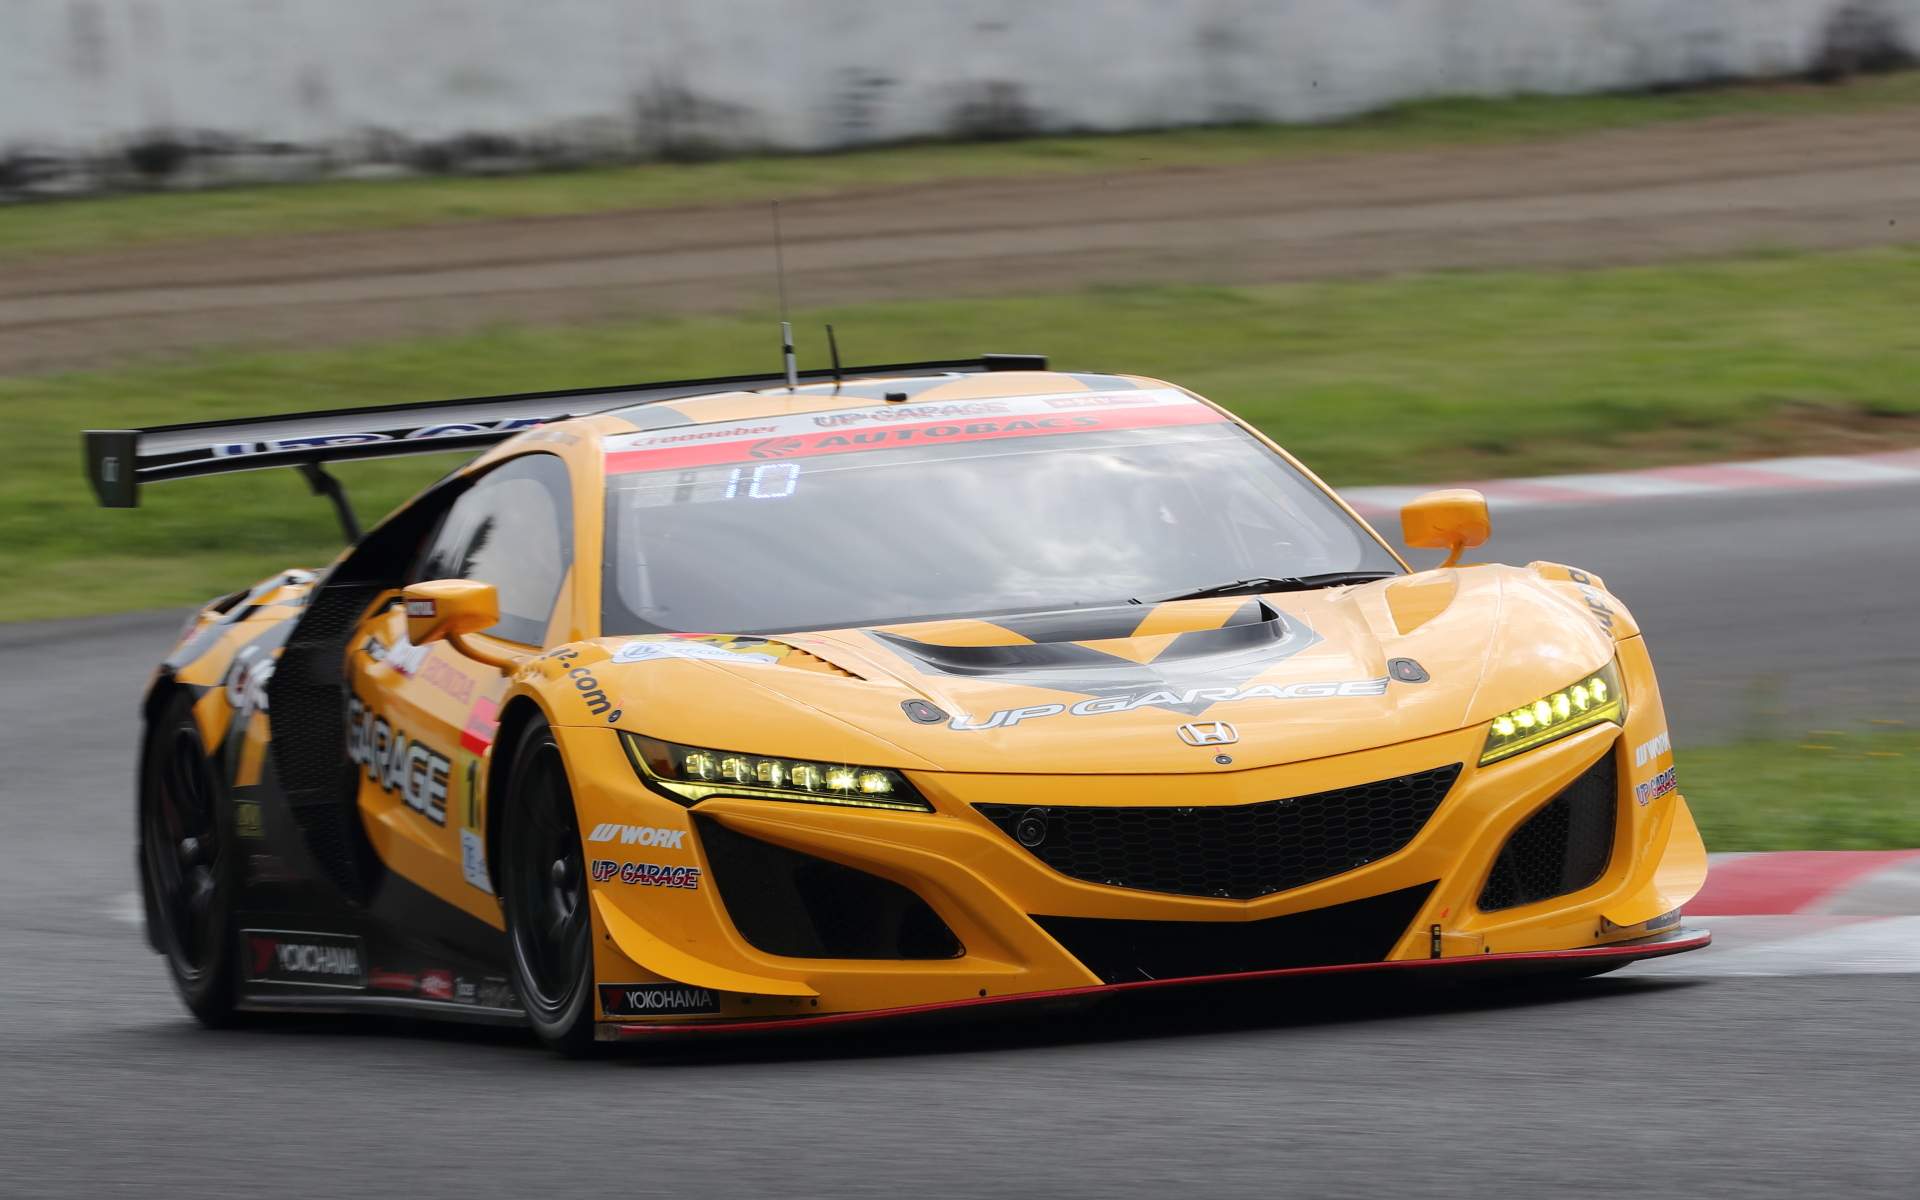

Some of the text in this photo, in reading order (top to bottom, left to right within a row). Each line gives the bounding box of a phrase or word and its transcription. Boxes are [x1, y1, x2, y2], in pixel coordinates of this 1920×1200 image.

[812, 402, 1010, 428] UP GARAGE
[814, 415, 1101, 448] AUTOBACS
[726, 463, 801, 500] 10
[947, 677, 1391, 732] UP GARAGE
[1646, 730, 1671, 760] WORK
[346, 697, 452, 828] GARAGE
[1635, 765, 1677, 806] UP GARAGE
[620, 825, 687, 849] WORK
[591, 859, 700, 889] UP GARAGE
[275, 943, 361, 975] YOKOHAMA
[626, 990, 712, 1009] YOKOHAMA
